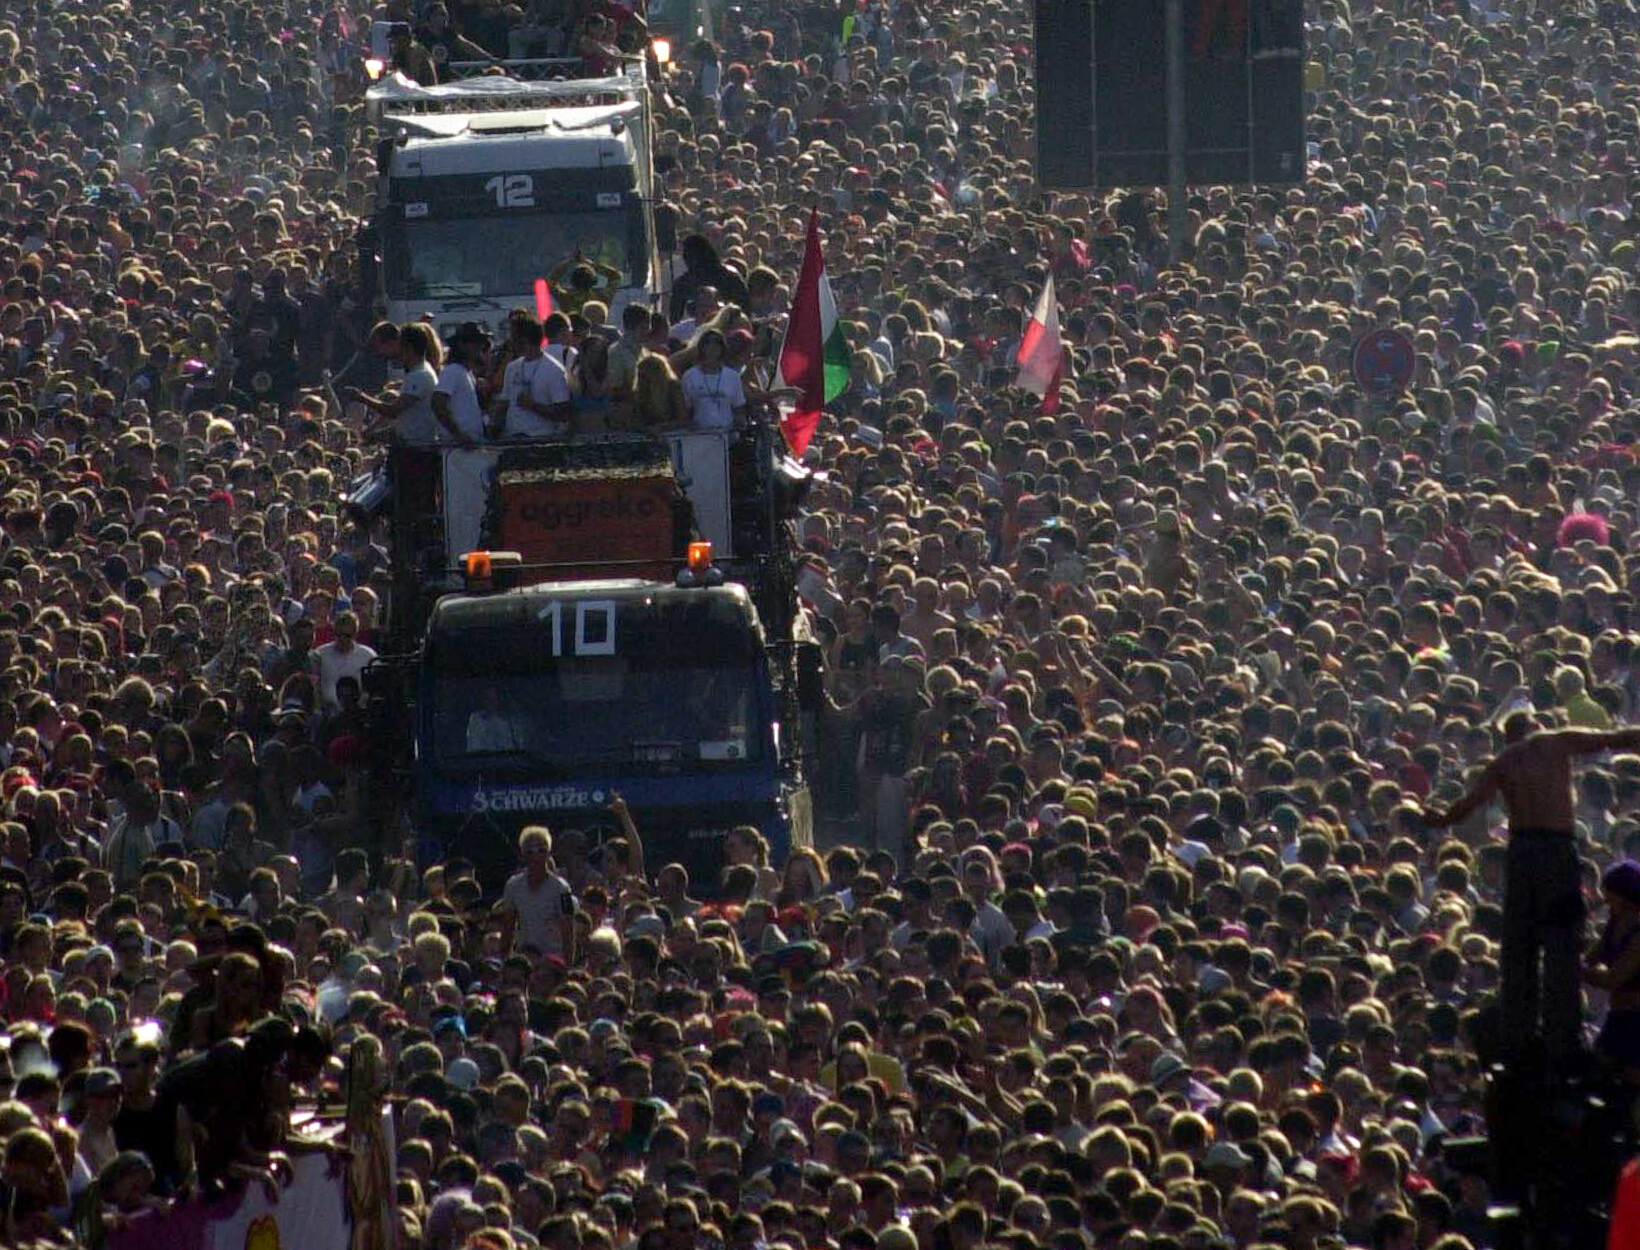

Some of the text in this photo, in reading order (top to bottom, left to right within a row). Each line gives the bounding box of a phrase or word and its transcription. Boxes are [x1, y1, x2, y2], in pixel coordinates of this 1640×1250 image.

[485, 174, 535, 209] 12
[519, 492, 654, 527] aggreko
[538, 600, 616, 657] 10
[472, 791, 589, 812] SCHWARZE
